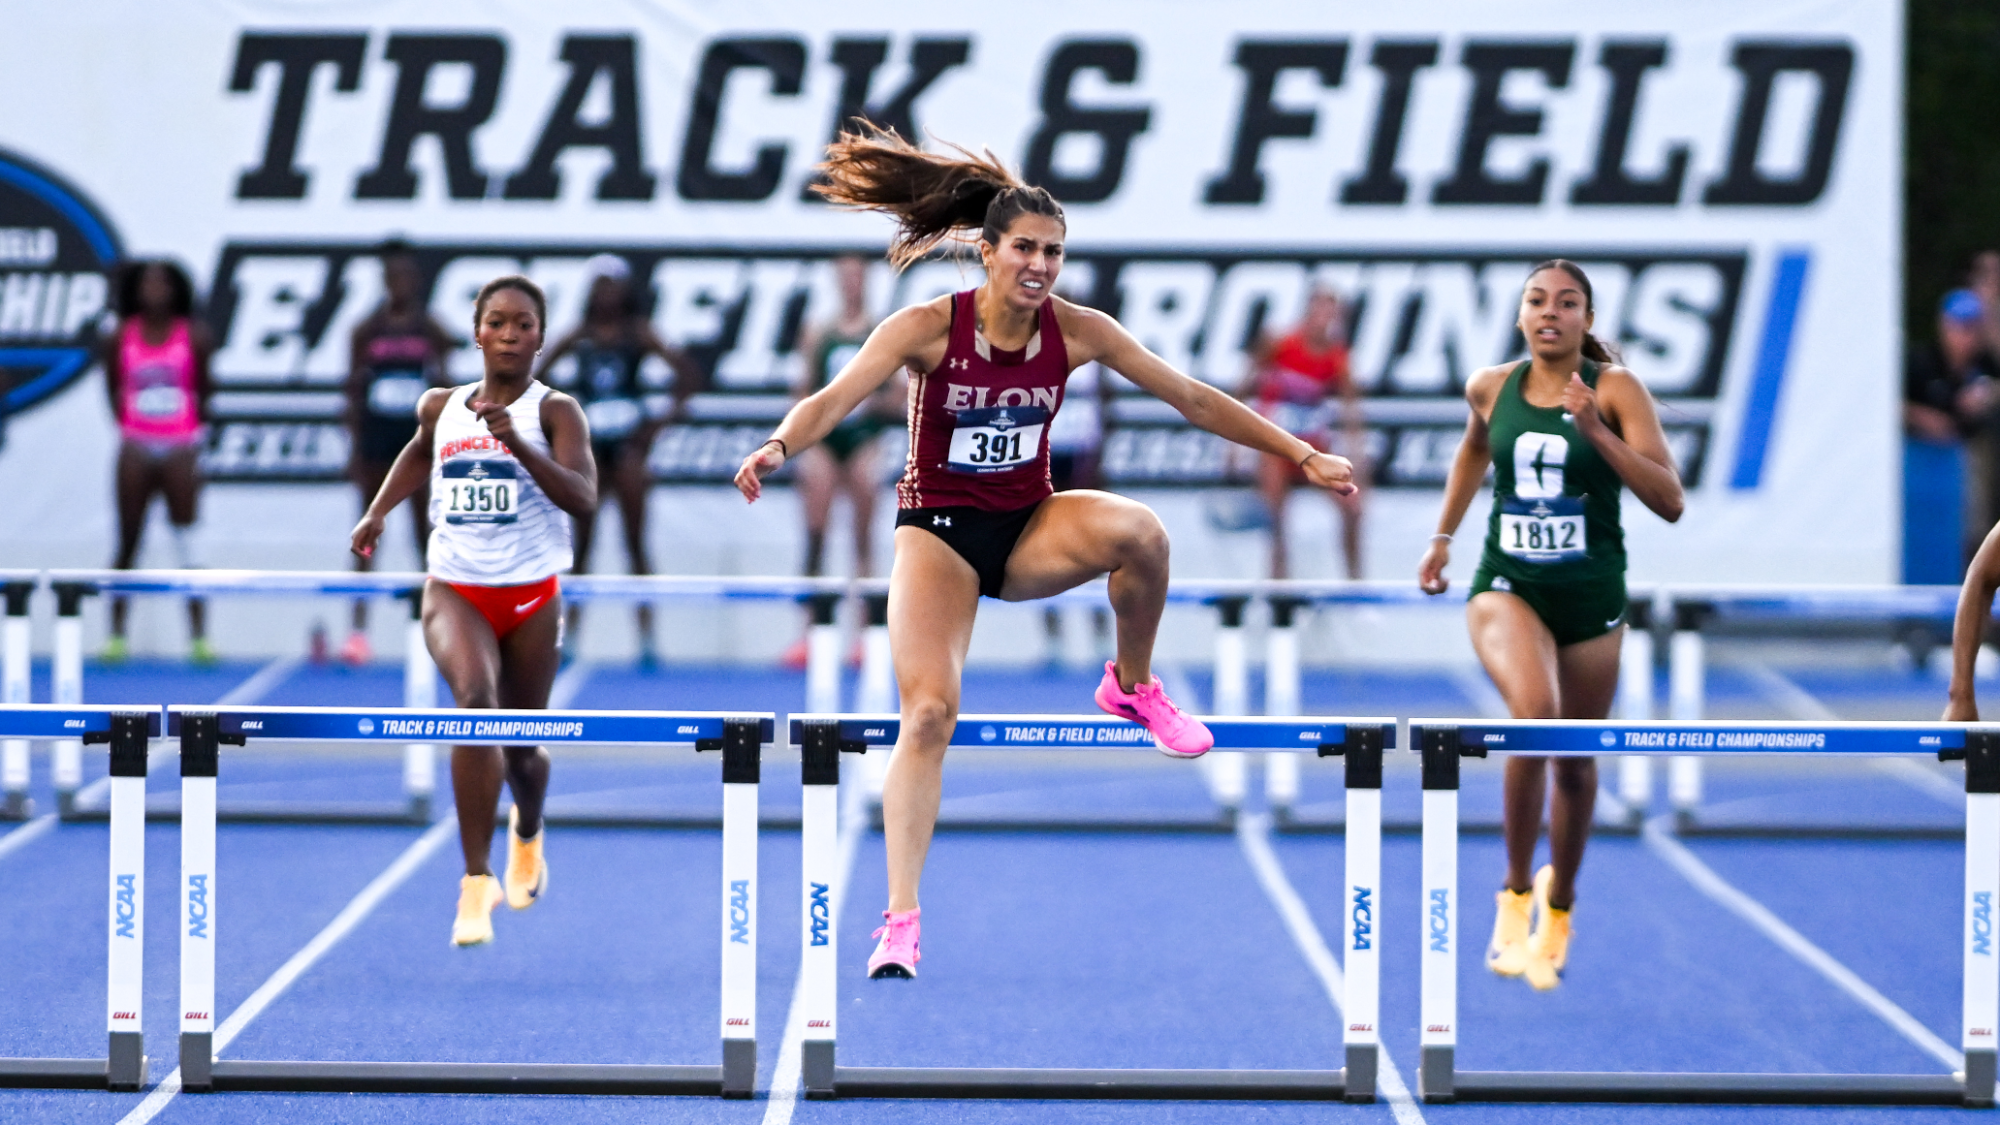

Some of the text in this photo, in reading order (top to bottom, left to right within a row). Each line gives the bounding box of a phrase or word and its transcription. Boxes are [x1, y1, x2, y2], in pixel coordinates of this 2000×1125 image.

[227, 33, 1854, 204] TRACK & FIELD
[942, 383, 1060, 414] ELON
[440, 434, 513, 464] PRINCET
[969, 432, 1022, 463] 391
[449, 484, 510, 512] 1350
[1512, 521, 1576, 550] 1812
[63, 719, 86, 728] GILL
[241, 720, 264, 729] GILL
[382, 720, 424, 735] TRACK
[425, 720, 436, 735] &
[436, 721, 472, 735] FIELD
[474, 721, 584, 737] CHAMPIONSHIPS
[677, 725, 699, 734] GILL
[863, 728, 886, 737] GILL
[1004, 727, 1046, 741] TRACK
[1047, 727, 1057, 741] &
[1058, 727, 1094, 742] FIELD
[1299, 731, 1322, 740] GILL
[1483, 733, 1507, 742] GILL
[1624, 732, 1666, 746] TRACK
[1667, 732, 1677, 746] &
[1678, 732, 1714, 747] FIELD
[1716, 733, 1826, 748] CHAMPIONSHIPS
[116, 873, 136, 939] NCAA
[189, 873, 208, 939] NCAA
[730, 879, 750, 945] NCAA
[810, 881, 830, 947] NCAA
[1352, 885, 1372, 951] NCAA
[1430, 888, 1449, 953] NCAA
[1972, 891, 1992, 956] NCAA
[112, 1011, 136, 1020] GILL
[185, 1011, 209, 1020] GILL
[726, 1017, 750, 1026] GILL
[807, 1019, 831, 1028] GILL
[1349, 1023, 1373, 1032] GILL
[1426, 1024, 1451, 1033] GILL
